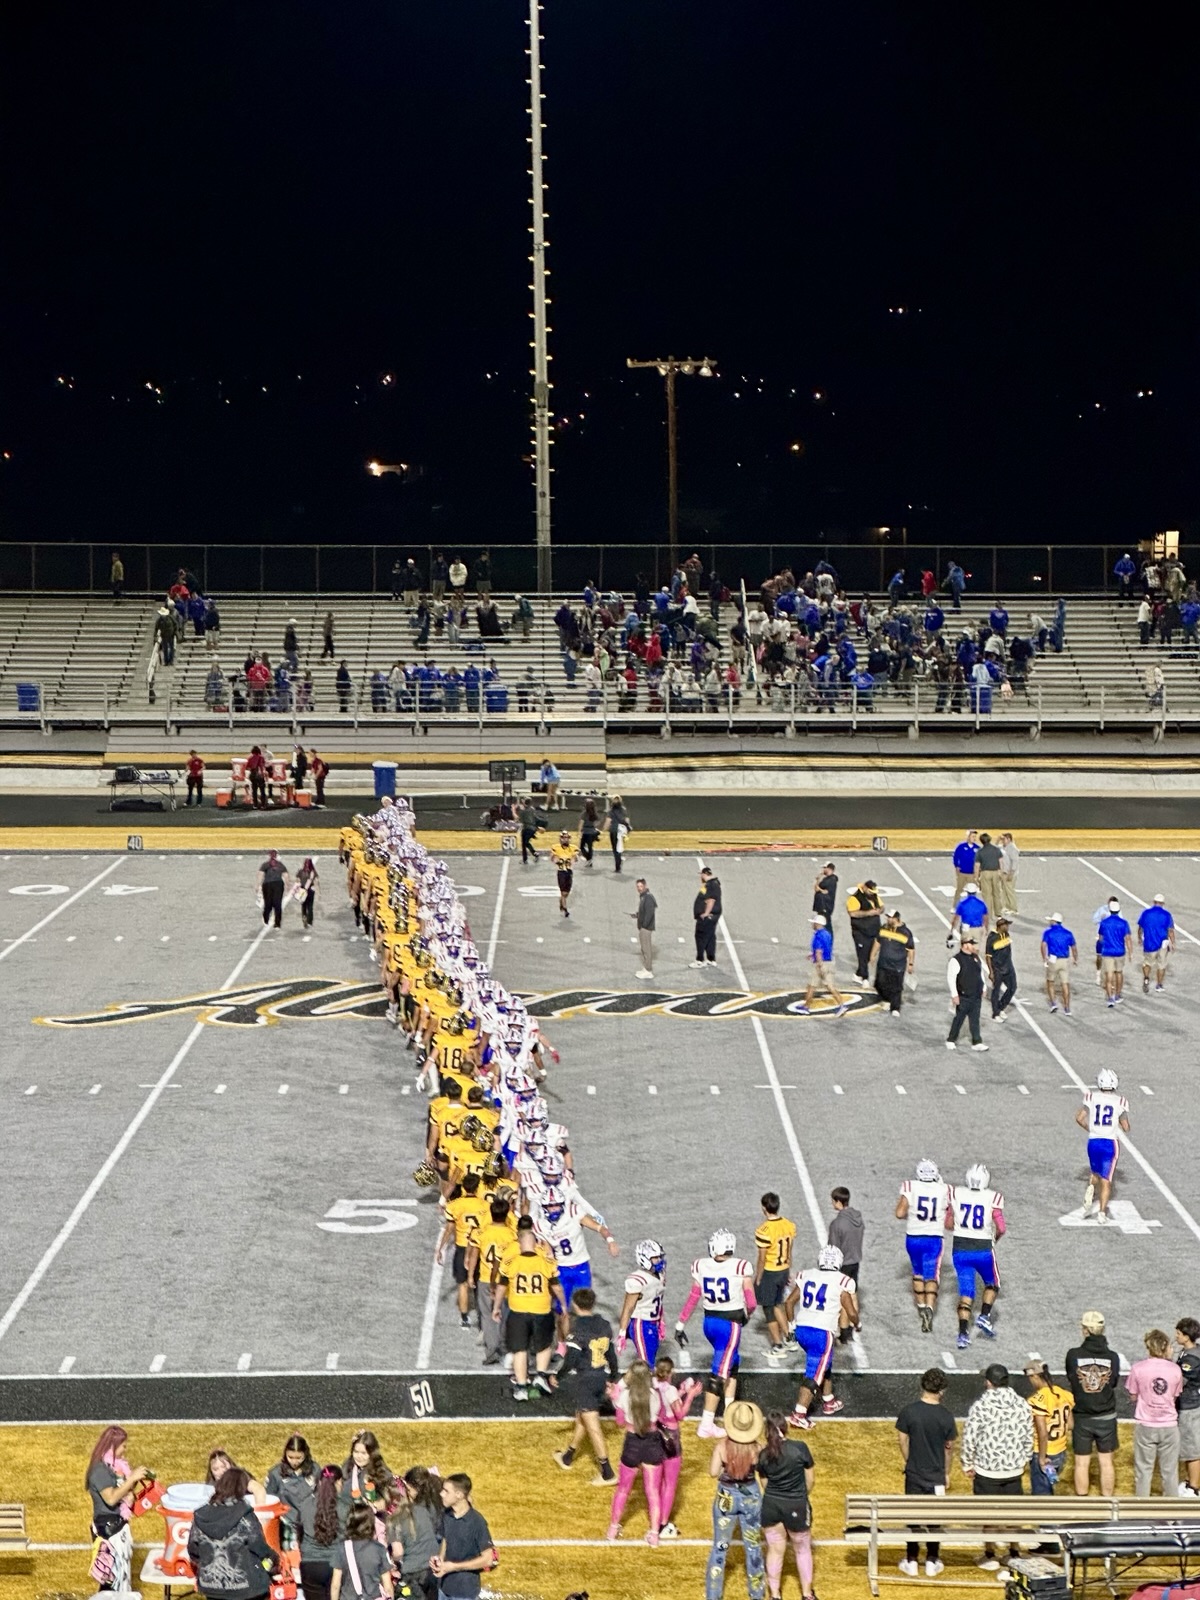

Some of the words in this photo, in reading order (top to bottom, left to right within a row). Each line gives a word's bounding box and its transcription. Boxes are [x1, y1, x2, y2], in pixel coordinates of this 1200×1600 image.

[128, 836, 142, 850] 40
[502, 836, 517, 850] 50
[873, 836, 888, 850] 40
[443, 1047, 462, 1069] 18
[1093, 1104, 1113, 1126] 12
[316, 1199, 419, 1233] 5
[917, 1196, 938, 1222] 51
[960, 1204, 985, 1229] 78
[1057, 1200, 1163, 1234] 4
[560, 1238, 573, 1256] 8
[776, 1237, 790, 1267] 11
[516, 1274, 543, 1294] 68
[703, 1276, 731, 1303] 53
[802, 1280, 828, 1311] 64
[409, 1380, 435, 1418] 50
